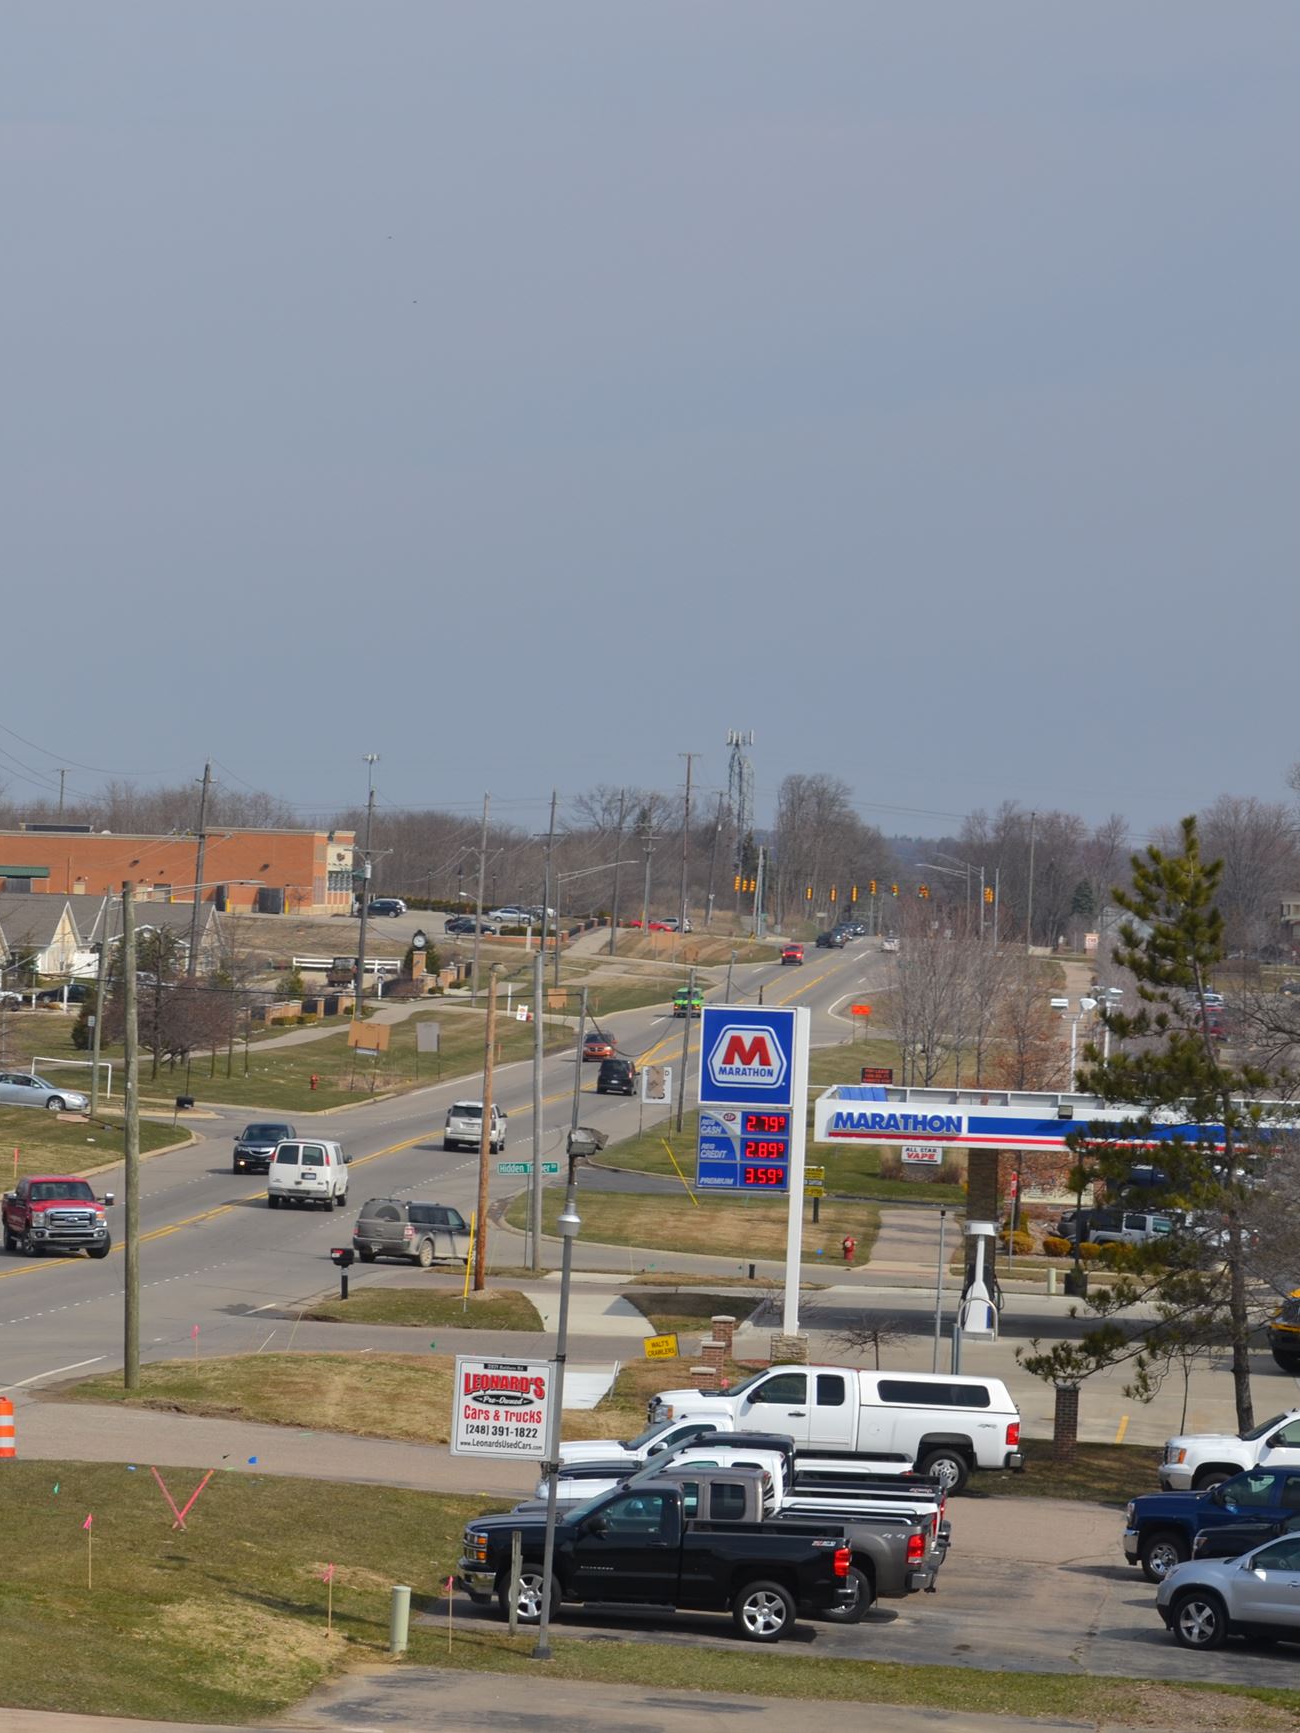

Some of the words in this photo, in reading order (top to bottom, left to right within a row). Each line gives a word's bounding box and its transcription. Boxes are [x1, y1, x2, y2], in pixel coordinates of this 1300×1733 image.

[722, 1035, 772, 1067] M
[718, 1066, 774, 1078] MARATHON
[833, 1112, 963, 1133] MARATHON
[700, 1126, 722, 1136] CASH
[700, 1150, 727, 1159] CREDIT
[907, 1152, 936, 1160] VAPE
[499, 1163, 524, 1172] Hidden
[700, 1177, 734, 1185] PREMIUM
[464, 1372, 545, 1400] LEONARD'S
[482, 1395, 523, 1405] Pre-Owned
[464, 1404, 490, 1421] Cars
[493, 1409, 501, 1422] &
[504, 1409, 542, 1424] Trucks
[491, 1425, 538, 1439] 391-1822
[460, 1438, 543, 1451] www.LeonardsUsedCars.com
